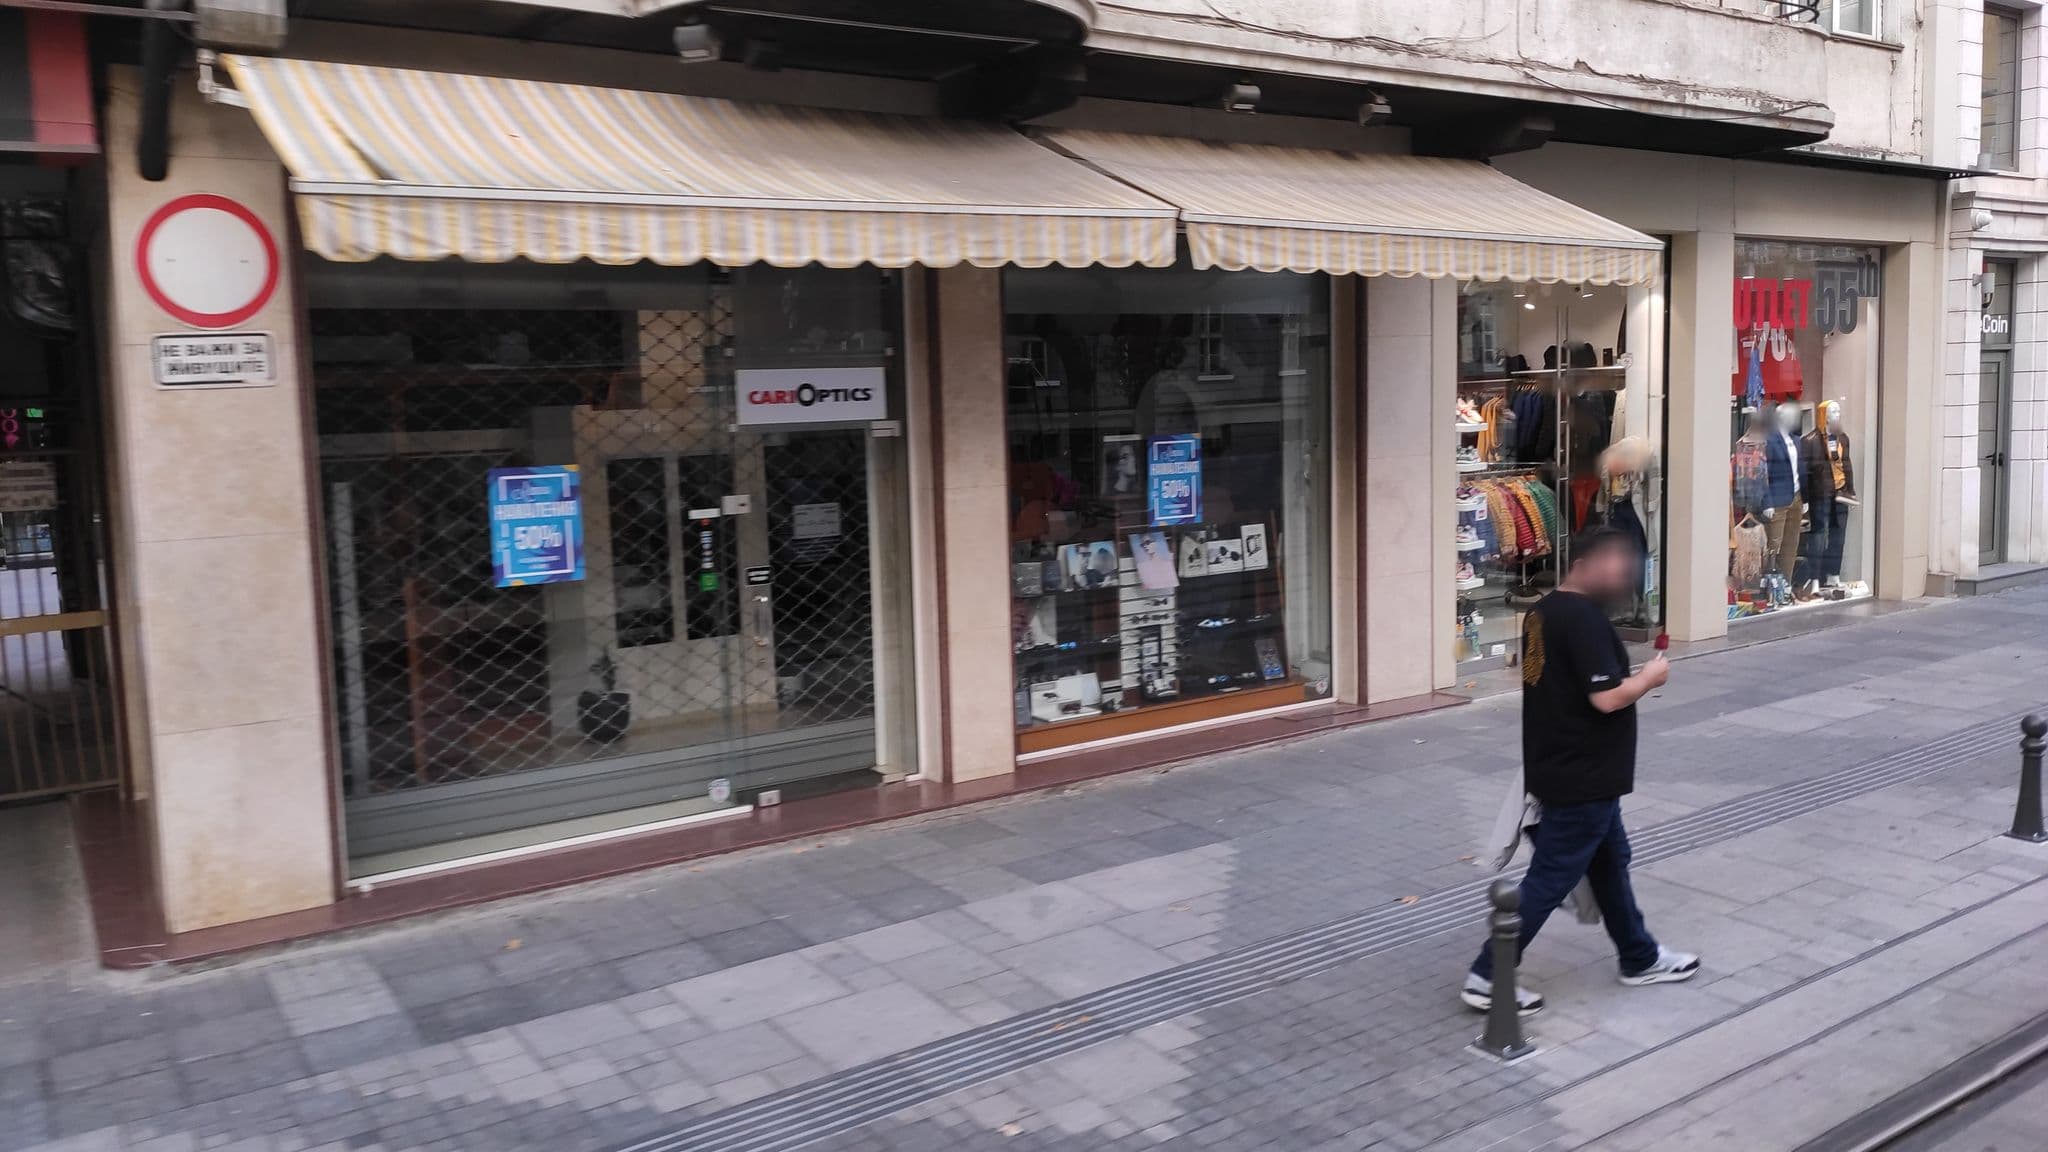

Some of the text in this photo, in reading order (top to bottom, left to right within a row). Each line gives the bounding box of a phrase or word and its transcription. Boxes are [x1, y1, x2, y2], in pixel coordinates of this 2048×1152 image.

[1815, 255, 1879, 334] 55th
[159, 344, 181, 357] НЕ
[748, 383, 872, 417] CARIOPTICS
[1161, 479, 1190, 499] 50%
[514, 525, 562, 550] 50%
